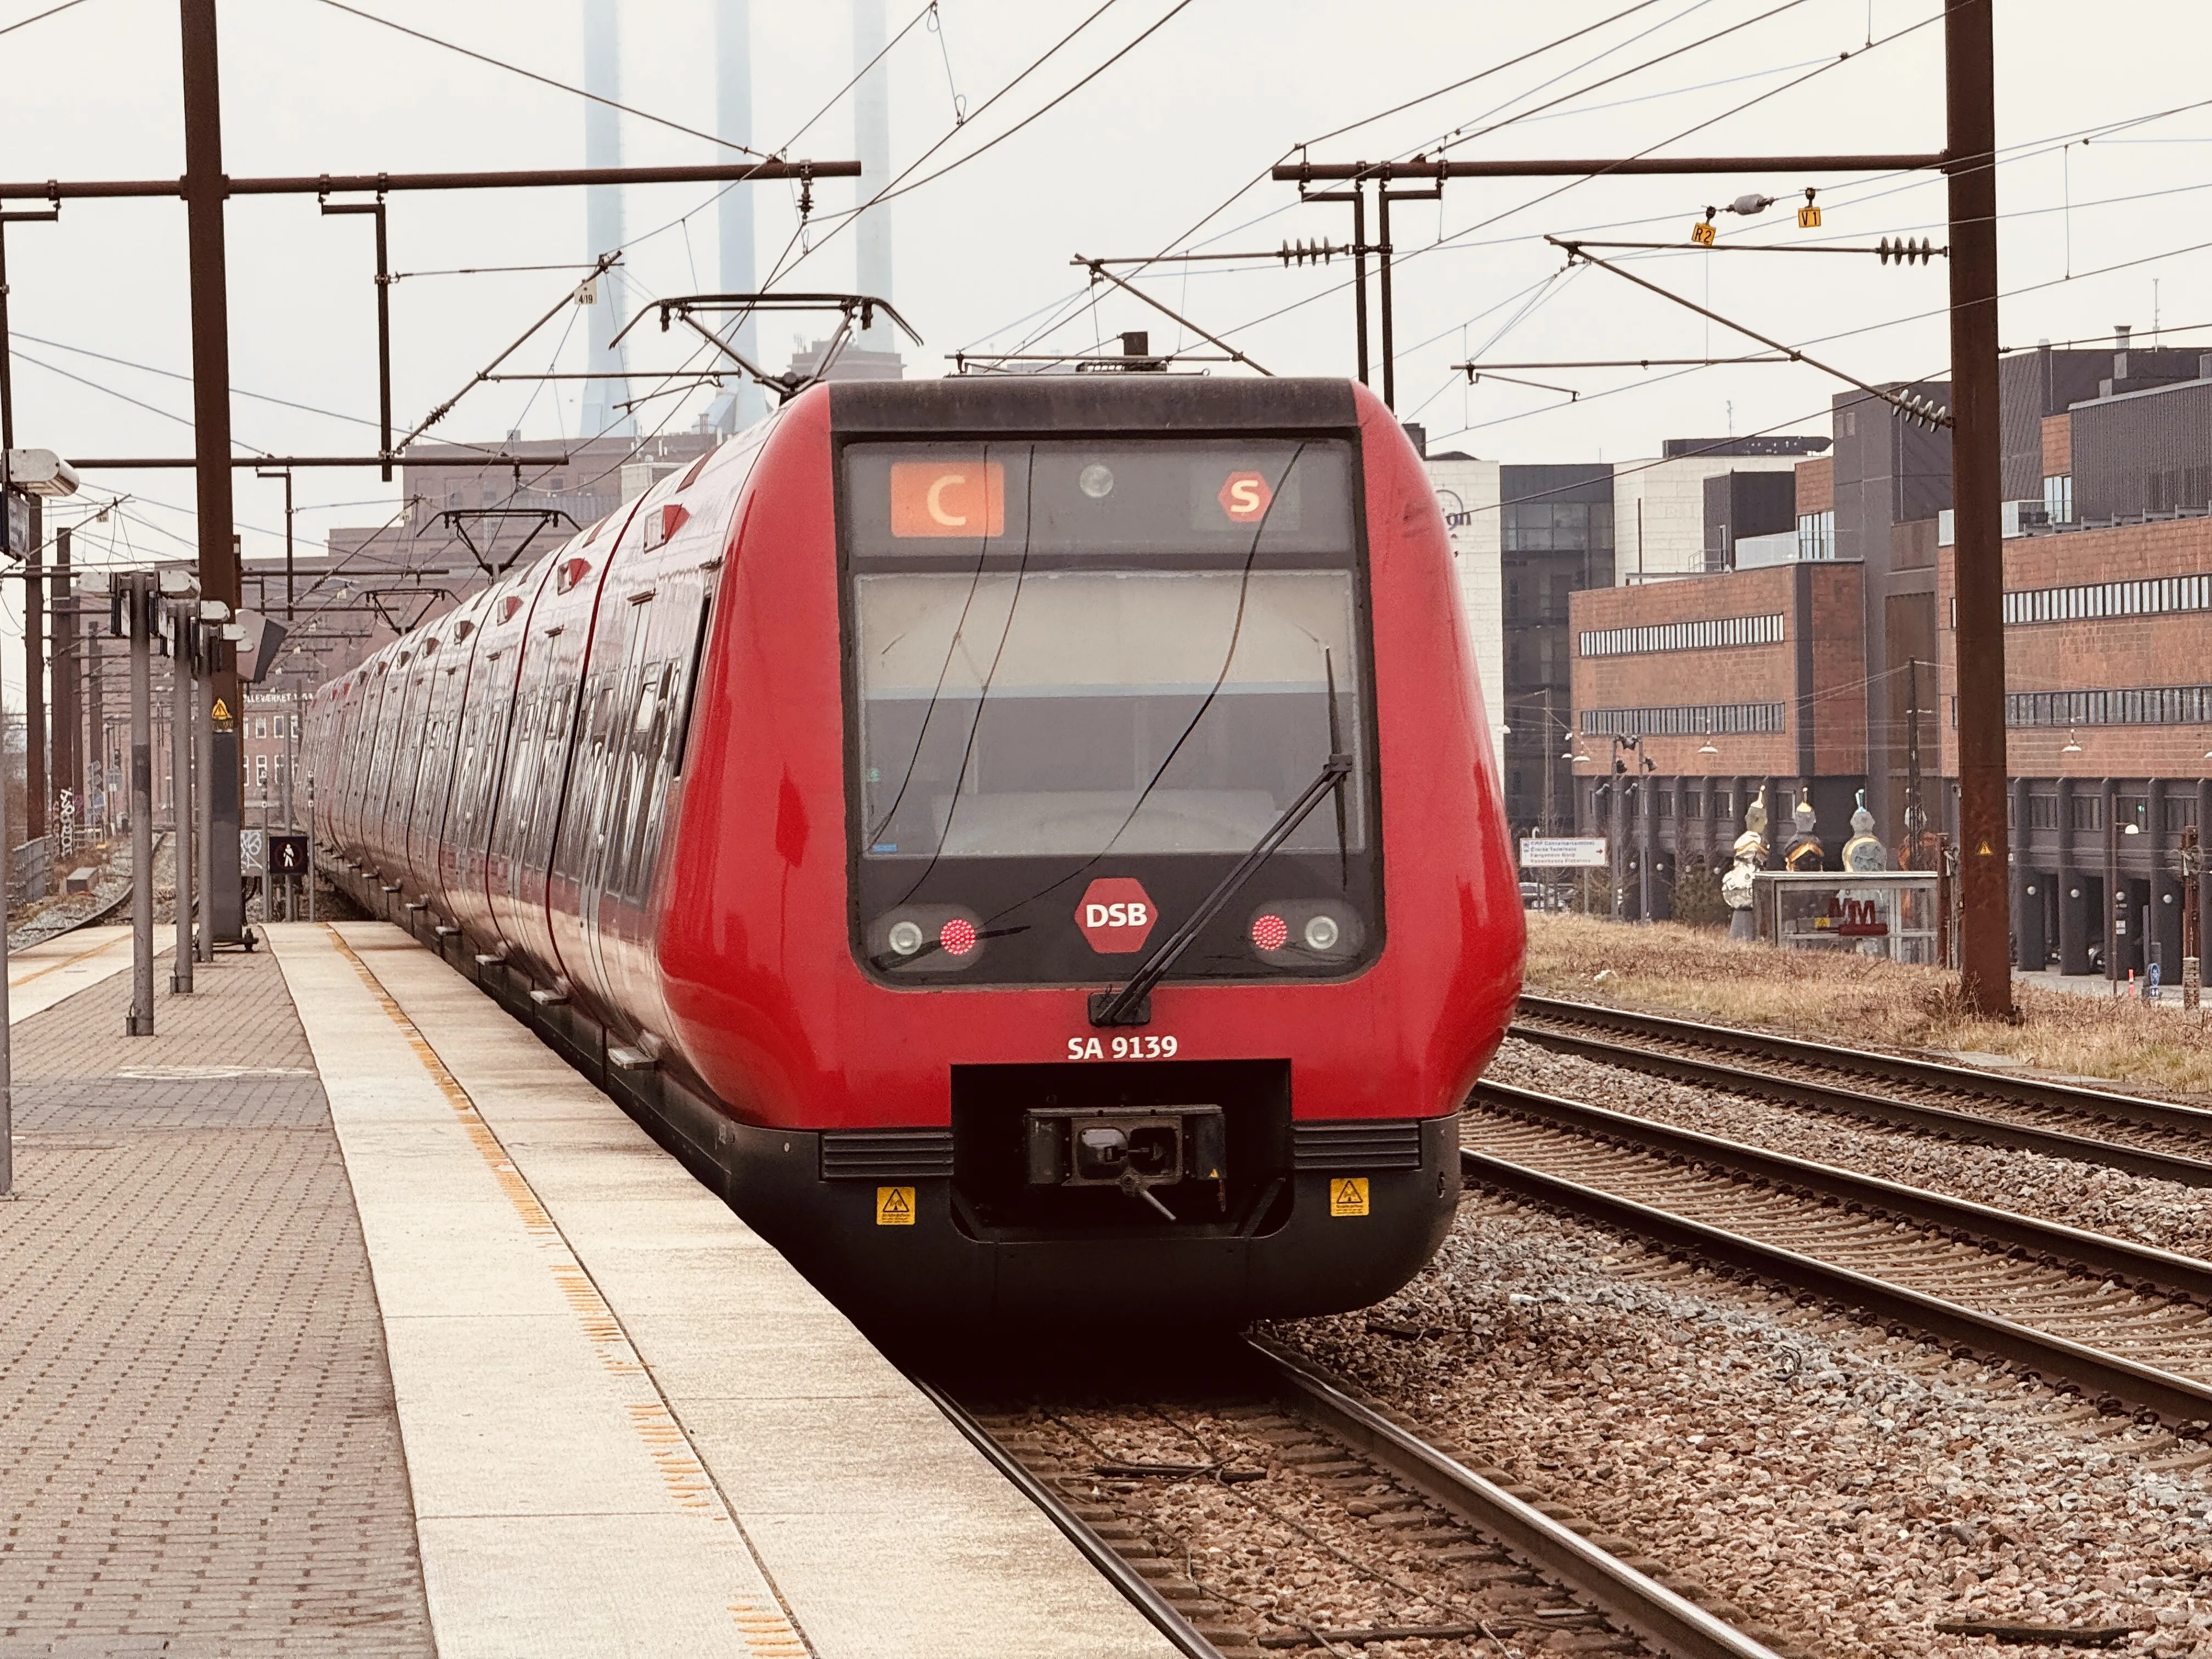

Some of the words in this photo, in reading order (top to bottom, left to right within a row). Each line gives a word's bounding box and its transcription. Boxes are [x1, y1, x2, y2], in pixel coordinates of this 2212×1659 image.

[1694, 227, 1712, 243] R2
[579, 294, 593, 304] 4/19
[927, 475, 966, 526] C
[1230, 479, 1260, 512] S
[1086, 903, 1148, 927] DSB
[1068, 1037, 1104, 1059] SA
[1111, 1036, 1178, 1059] 9139
